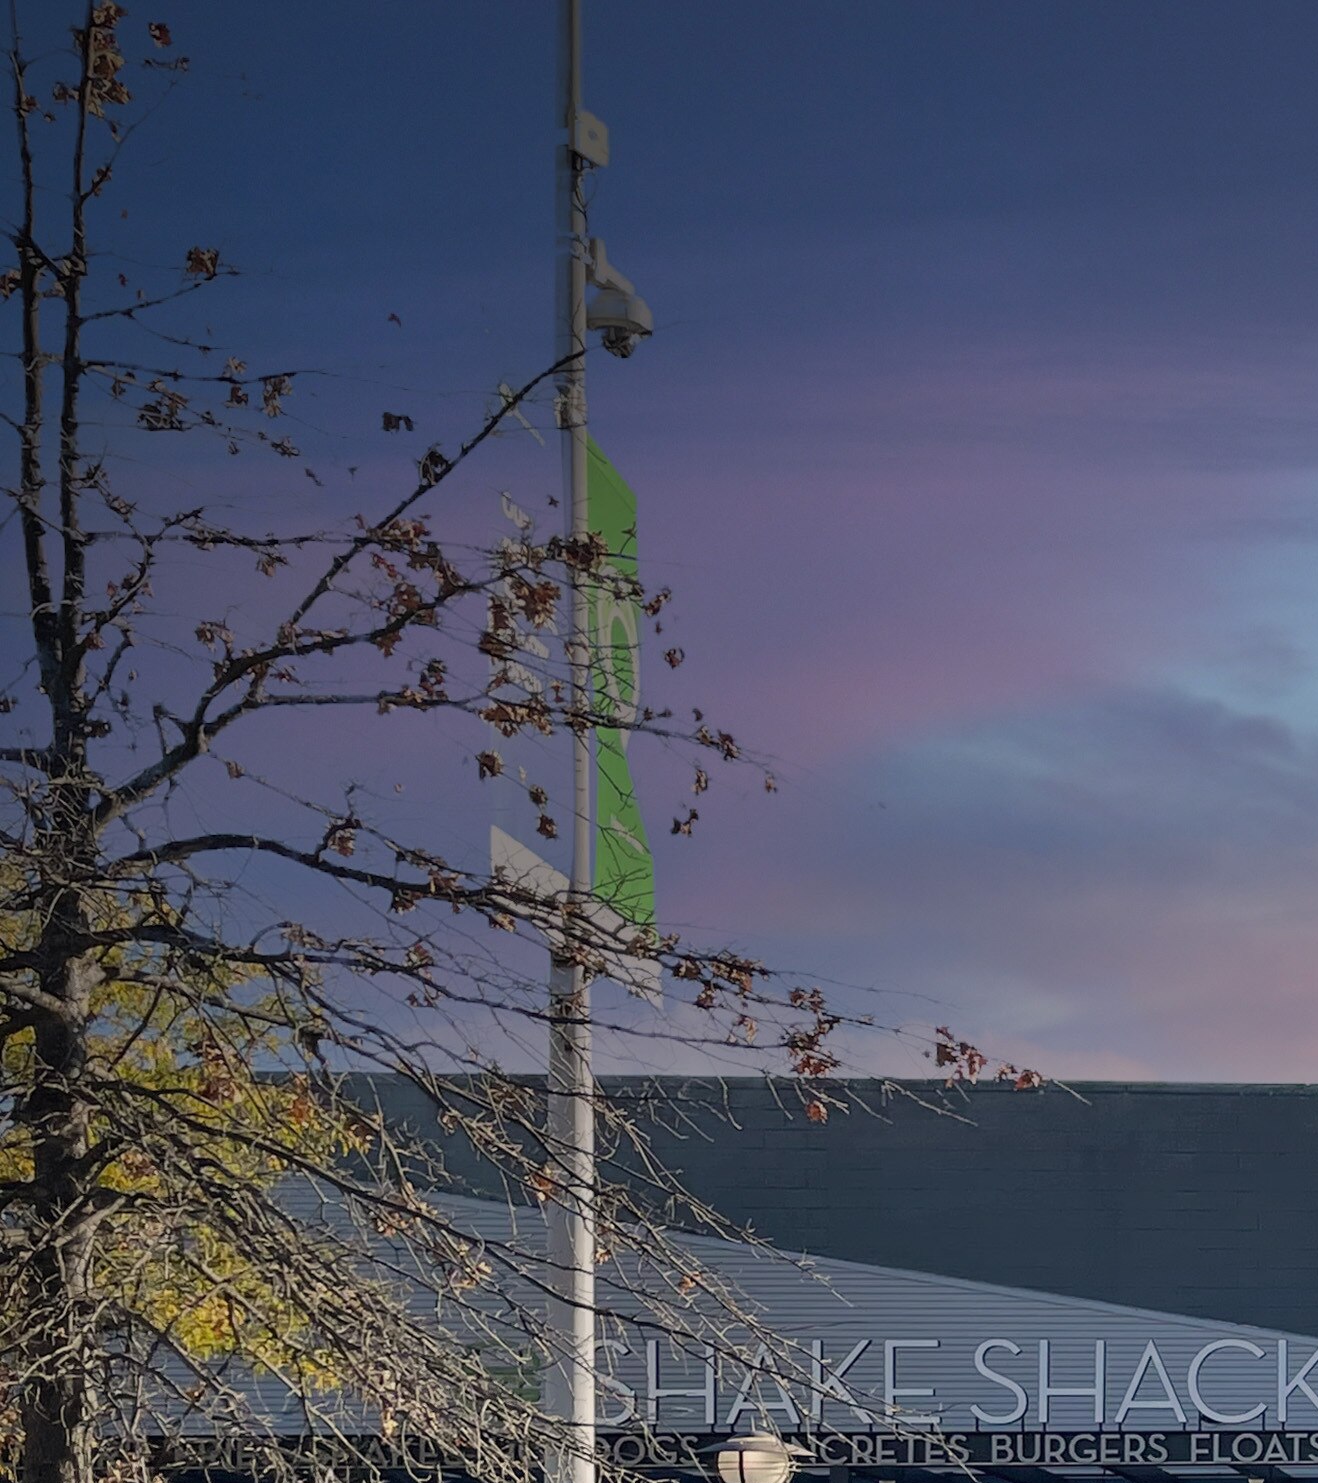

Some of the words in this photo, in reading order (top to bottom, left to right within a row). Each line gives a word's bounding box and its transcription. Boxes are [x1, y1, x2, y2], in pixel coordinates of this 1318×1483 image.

[594, 1339, 941, 1425] SHAKE
[789, 1434, 969, 1464] NCRETES
[991, 1433, 1169, 1464] BURGERS
